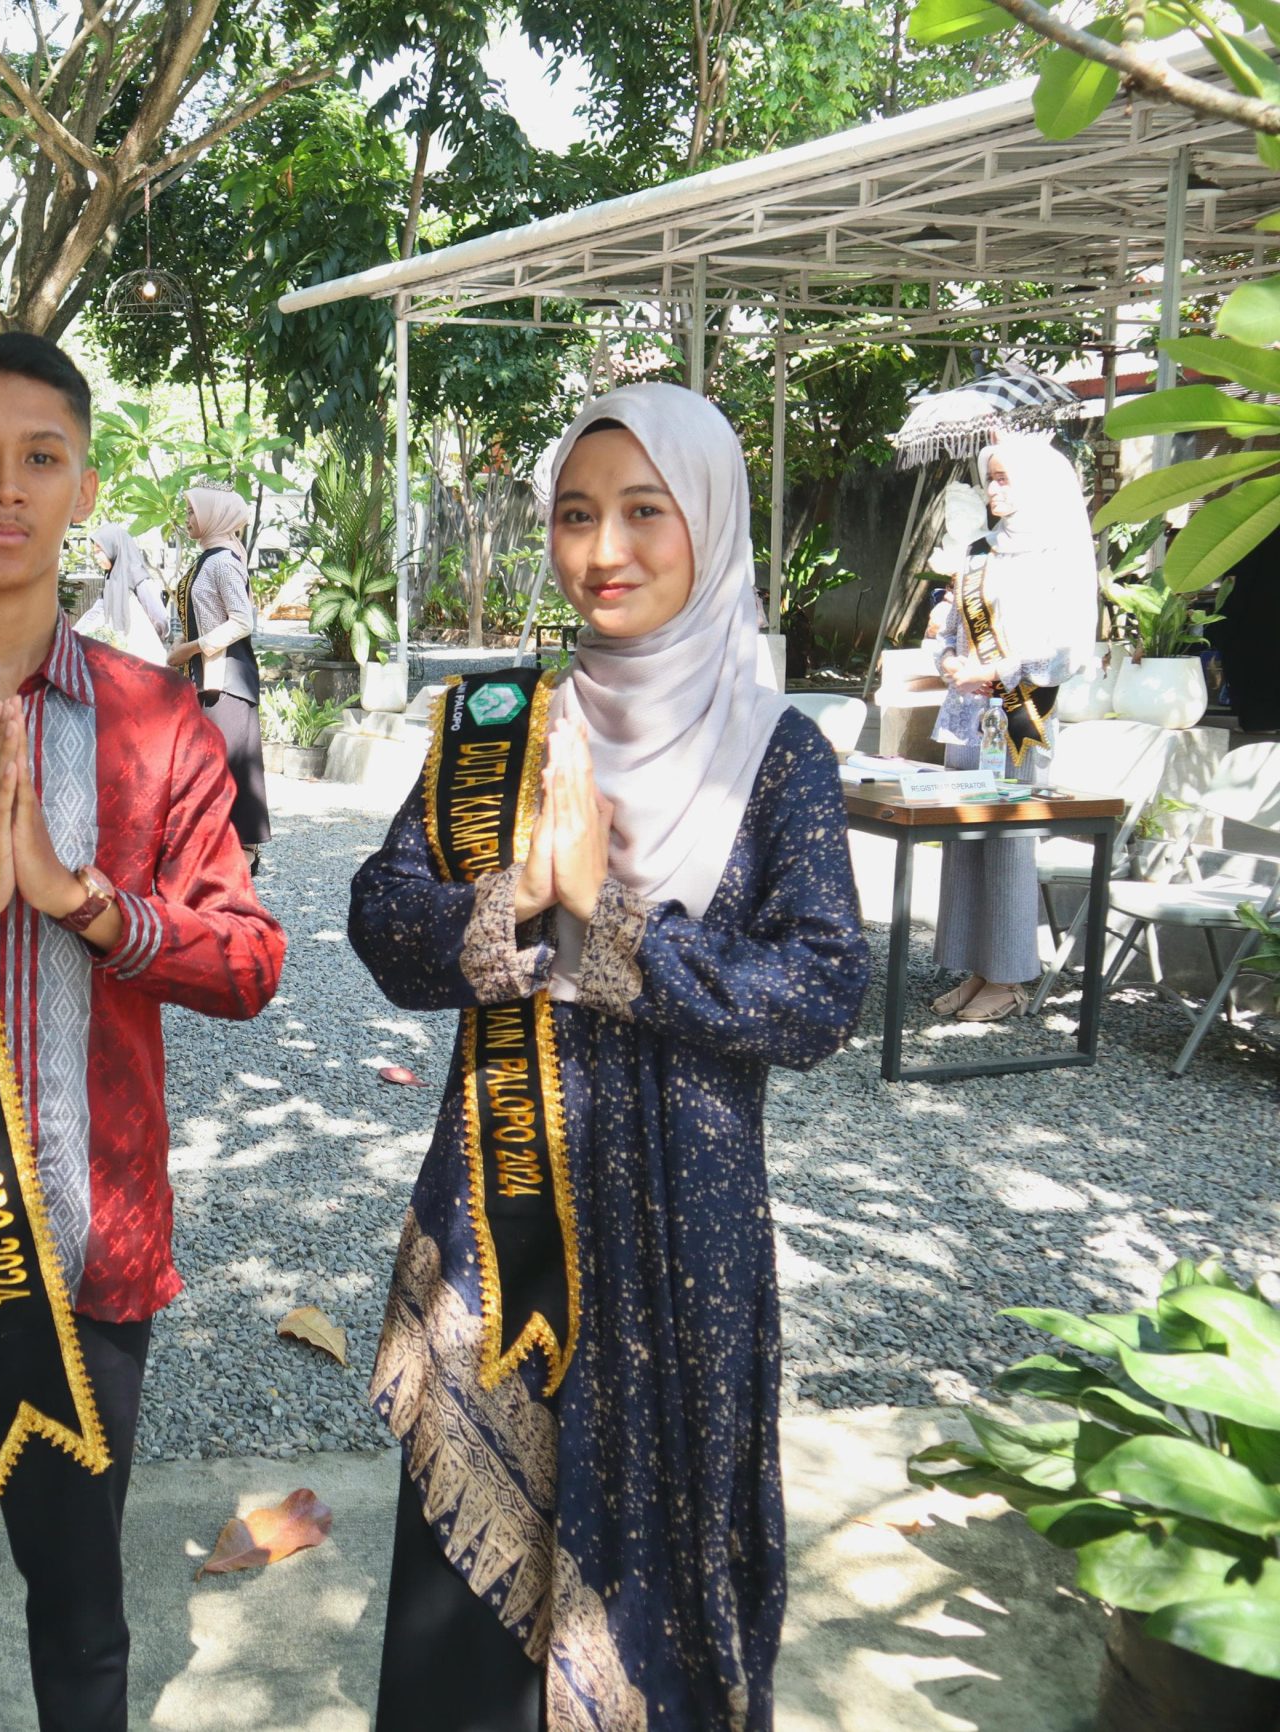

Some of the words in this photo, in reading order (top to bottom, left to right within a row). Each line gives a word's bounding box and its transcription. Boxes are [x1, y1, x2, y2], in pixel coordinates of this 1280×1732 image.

[451, 694, 465, 731] PALOPO
[450, 741, 511, 791] DUTA
[951, 781, 987, 790] OPERATOR
[485, 1008, 526, 1049] IAIN
[487, 1057, 537, 1144] PALOPO
[495, 1147, 544, 1198] 2024
